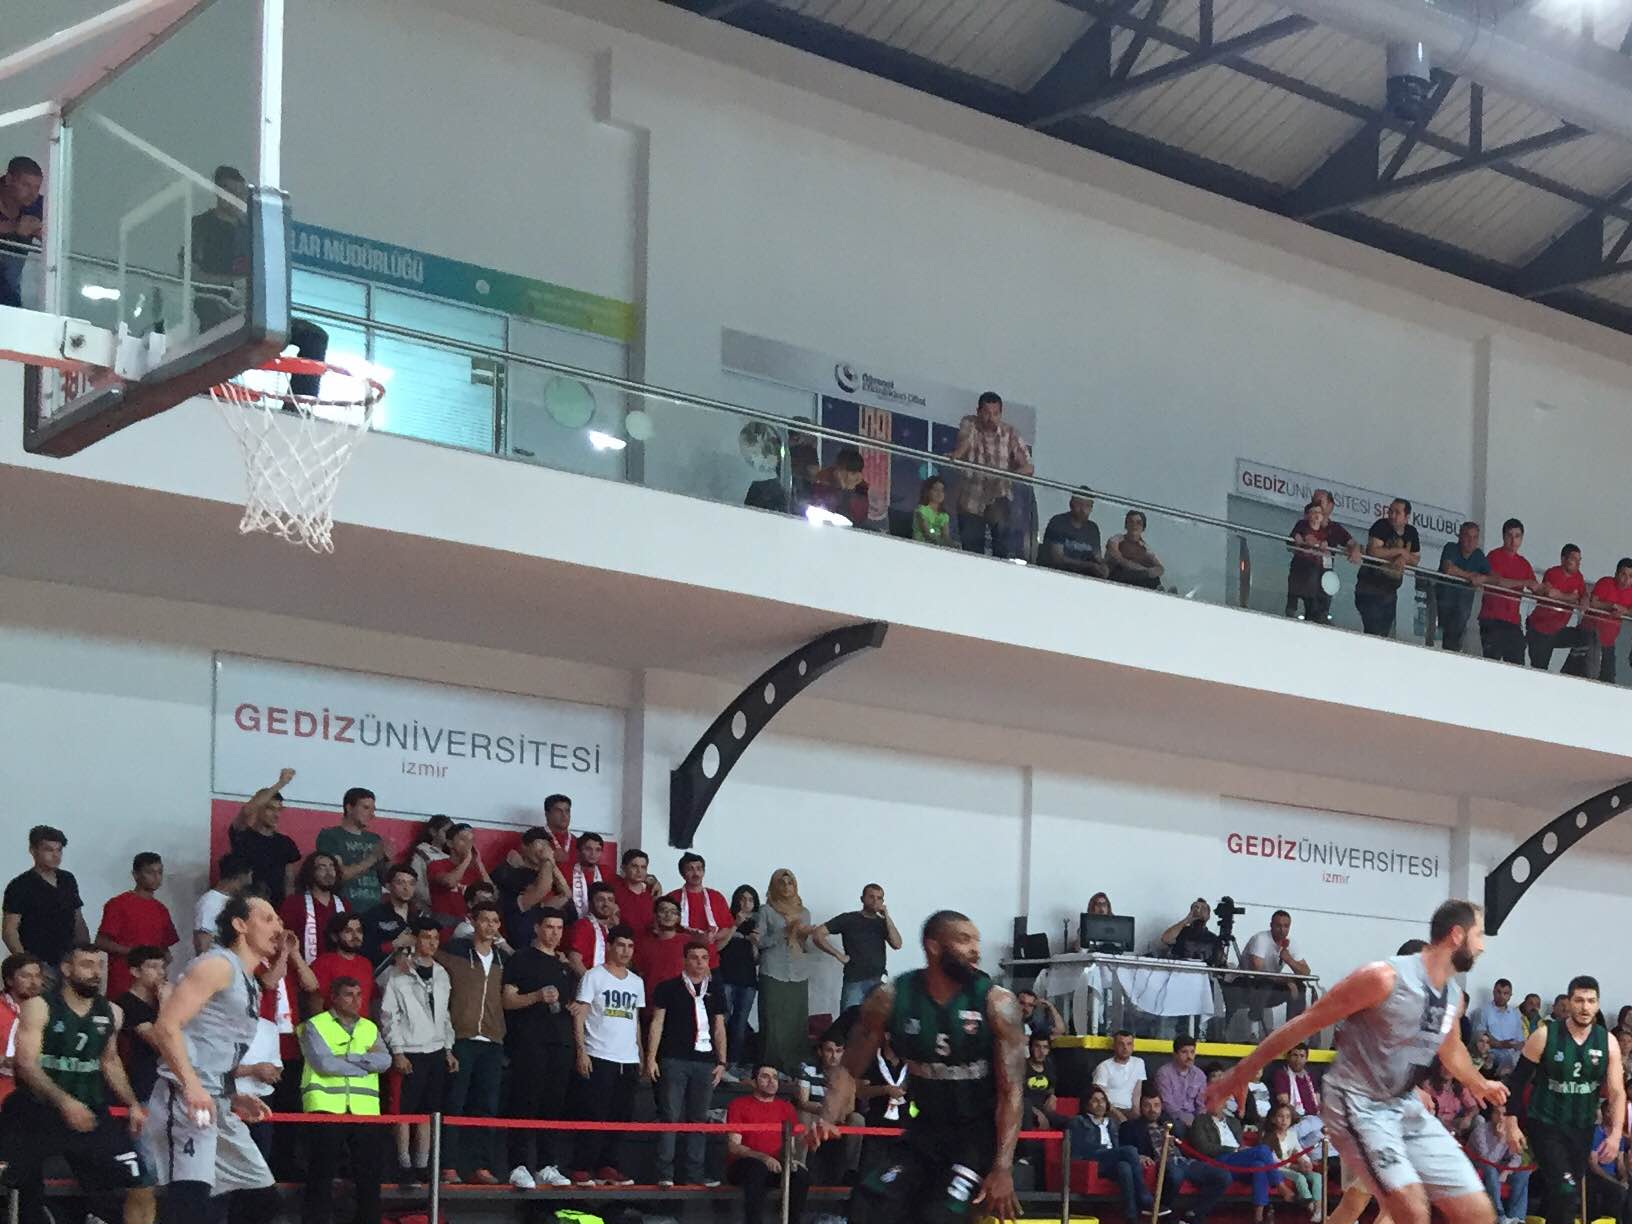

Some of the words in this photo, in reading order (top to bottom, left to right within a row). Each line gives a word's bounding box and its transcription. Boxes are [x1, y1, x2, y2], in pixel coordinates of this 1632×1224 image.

[75, 1032, 89, 1051] 7
[1572, 1062, 1582, 1077] 2
[183, 1137, 196, 1157] 4
